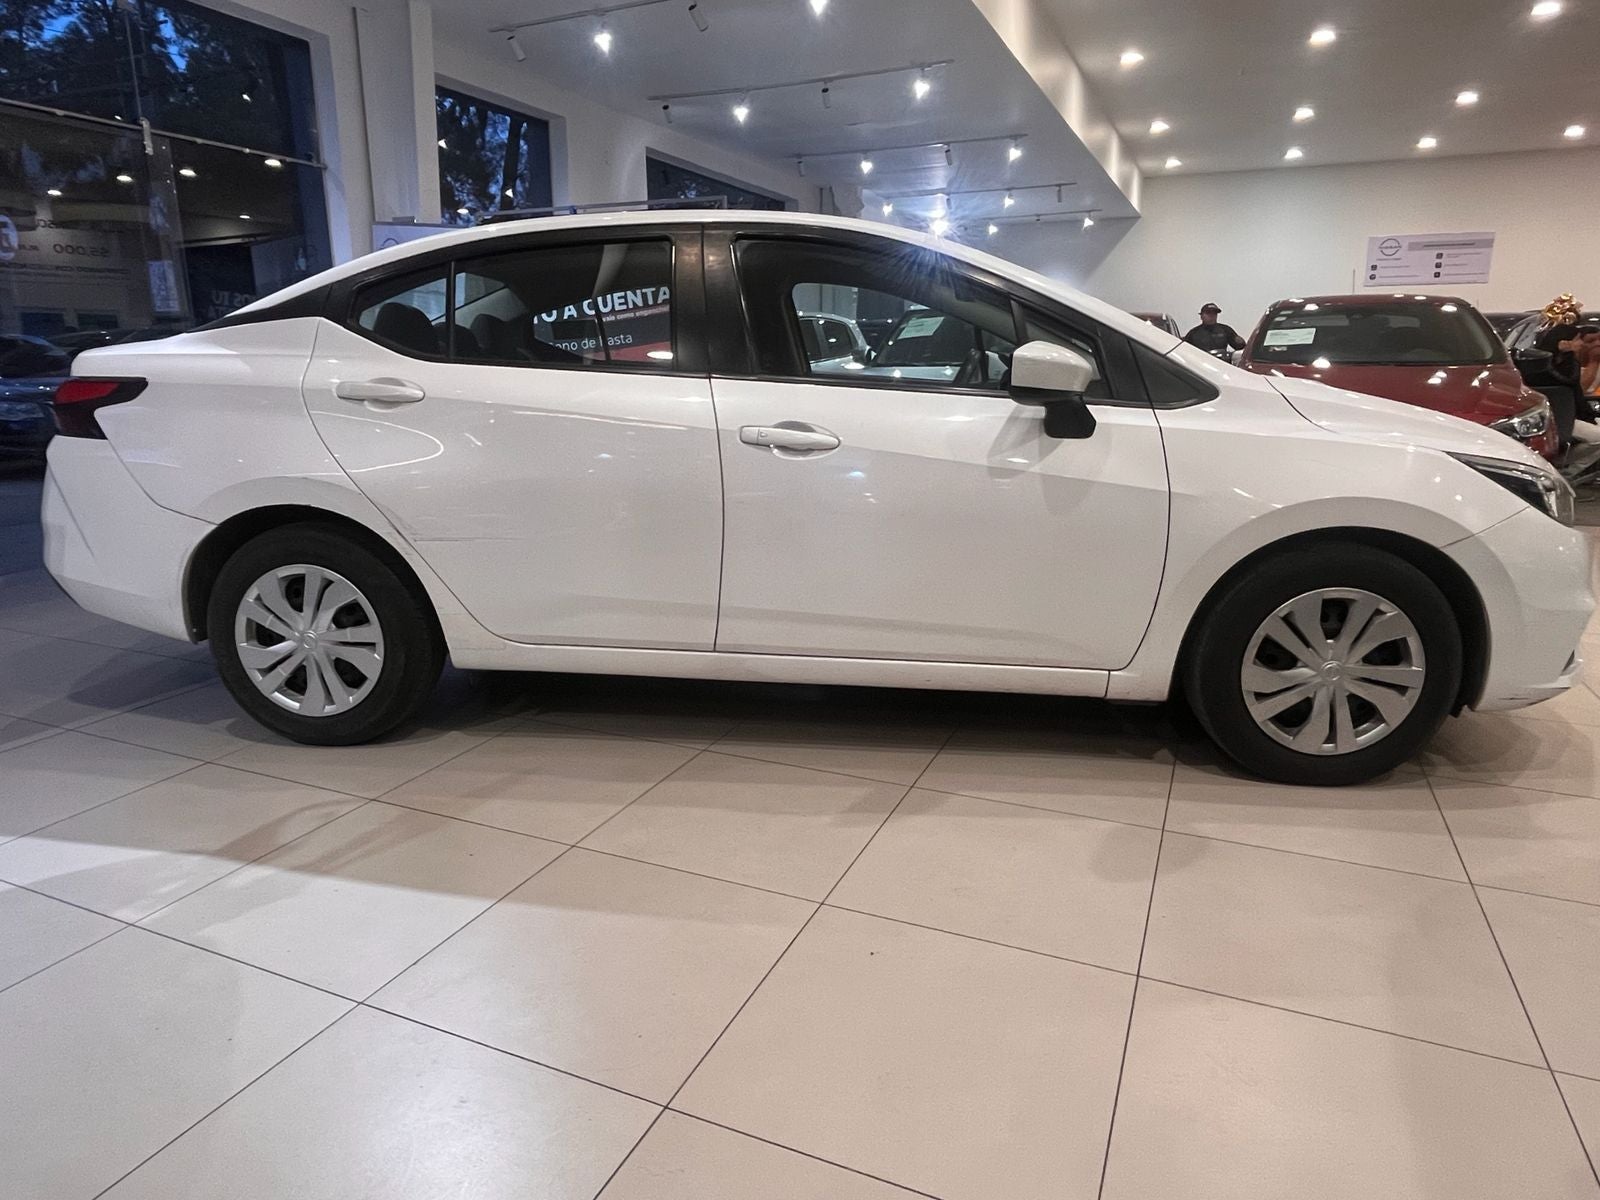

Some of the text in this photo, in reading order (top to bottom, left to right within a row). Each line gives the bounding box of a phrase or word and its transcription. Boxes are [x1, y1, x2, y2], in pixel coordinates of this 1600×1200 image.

[563, 304, 577, 319] A
[582, 286, 670, 316] CUENTA
[581, 337, 596, 350] de
